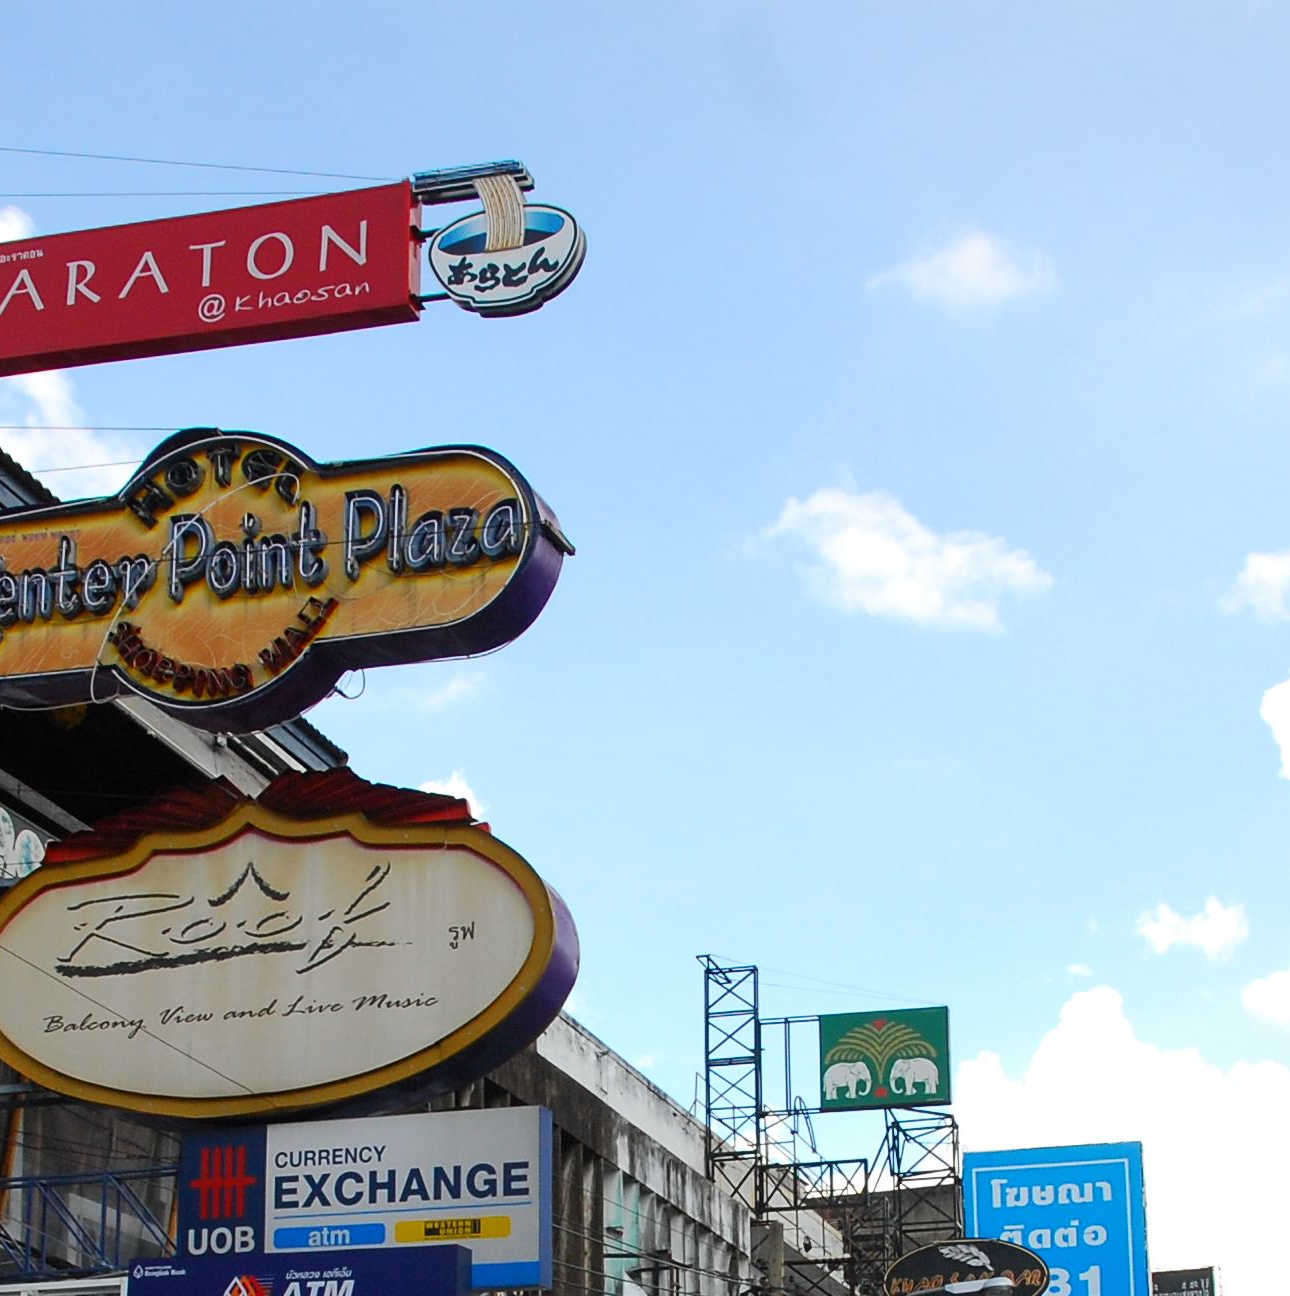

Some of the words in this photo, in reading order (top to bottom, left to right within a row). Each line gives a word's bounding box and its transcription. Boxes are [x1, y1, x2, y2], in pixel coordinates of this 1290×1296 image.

[447, 246, 560, 293] あらとん
[126, 444, 305, 529] HOTEL
[167, 500, 329, 602] Point
[343, 484, 525, 581] Plaza
[43, 1015, 145, 1039] Balcony
[159, 1008, 213, 1025] View
[223, 1005, 277, 1020] and
[281, 995, 343, 1018] Live
[352, 992, 440, 1010] Music
[273, 1145, 387, 1168] CURRENCY
[272, 1161, 531, 1209] EXCHANGE
[990, 1178, 1113, 1208] โฆษณา
[307, 1226, 351, 1247] atm
[425, 1220, 472, 1229] WESTERN
[439, 1227, 472, 1235] UNION
[187, 1226, 255, 1256] UOB
